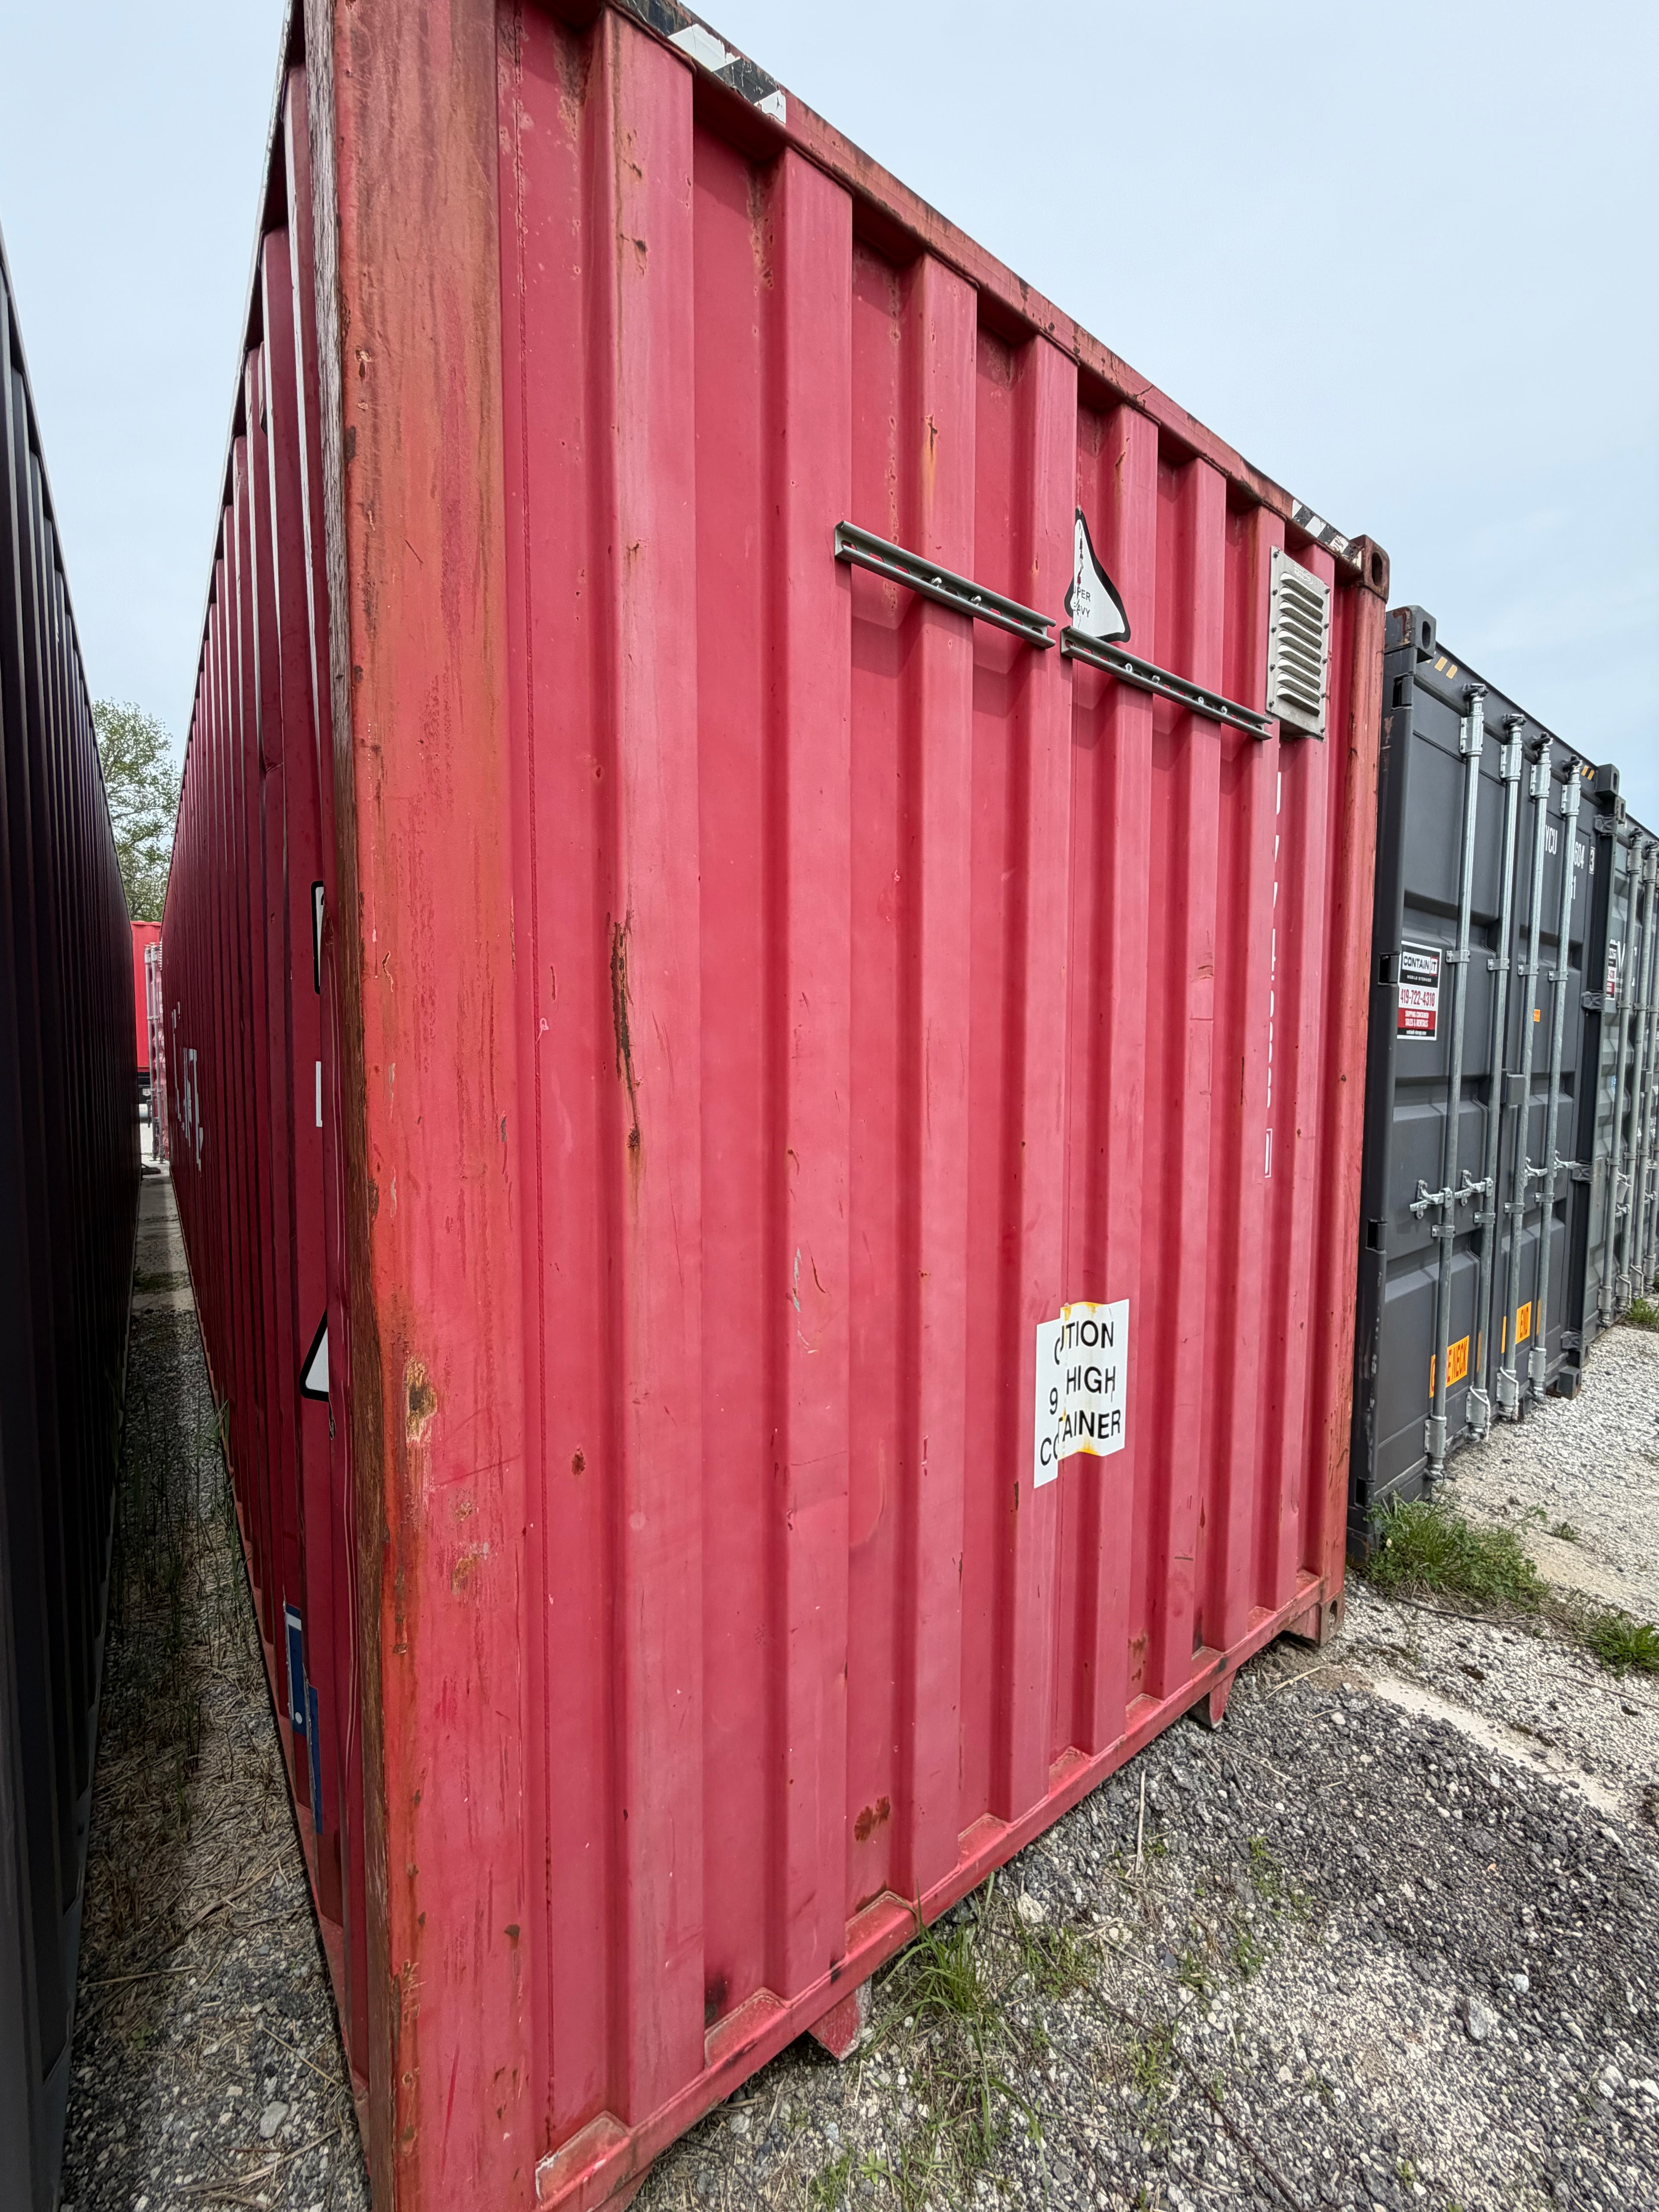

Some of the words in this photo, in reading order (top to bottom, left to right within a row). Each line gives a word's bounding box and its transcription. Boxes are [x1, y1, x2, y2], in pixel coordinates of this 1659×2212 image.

[1074, 585, 1091, 602] PER
[1073, 602, 1090, 618] AVY
[1545, 824, 1558, 855] YCU
[1589, 848, 1595, 873] 3
[1400, 988, 1435, 1007] 419-722-4310
[1452, 1340, 1468, 1380] NECK
[1066, 1365, 1116, 1395] HIGH
[1040, 1409, 1121, 1466] CAINER
